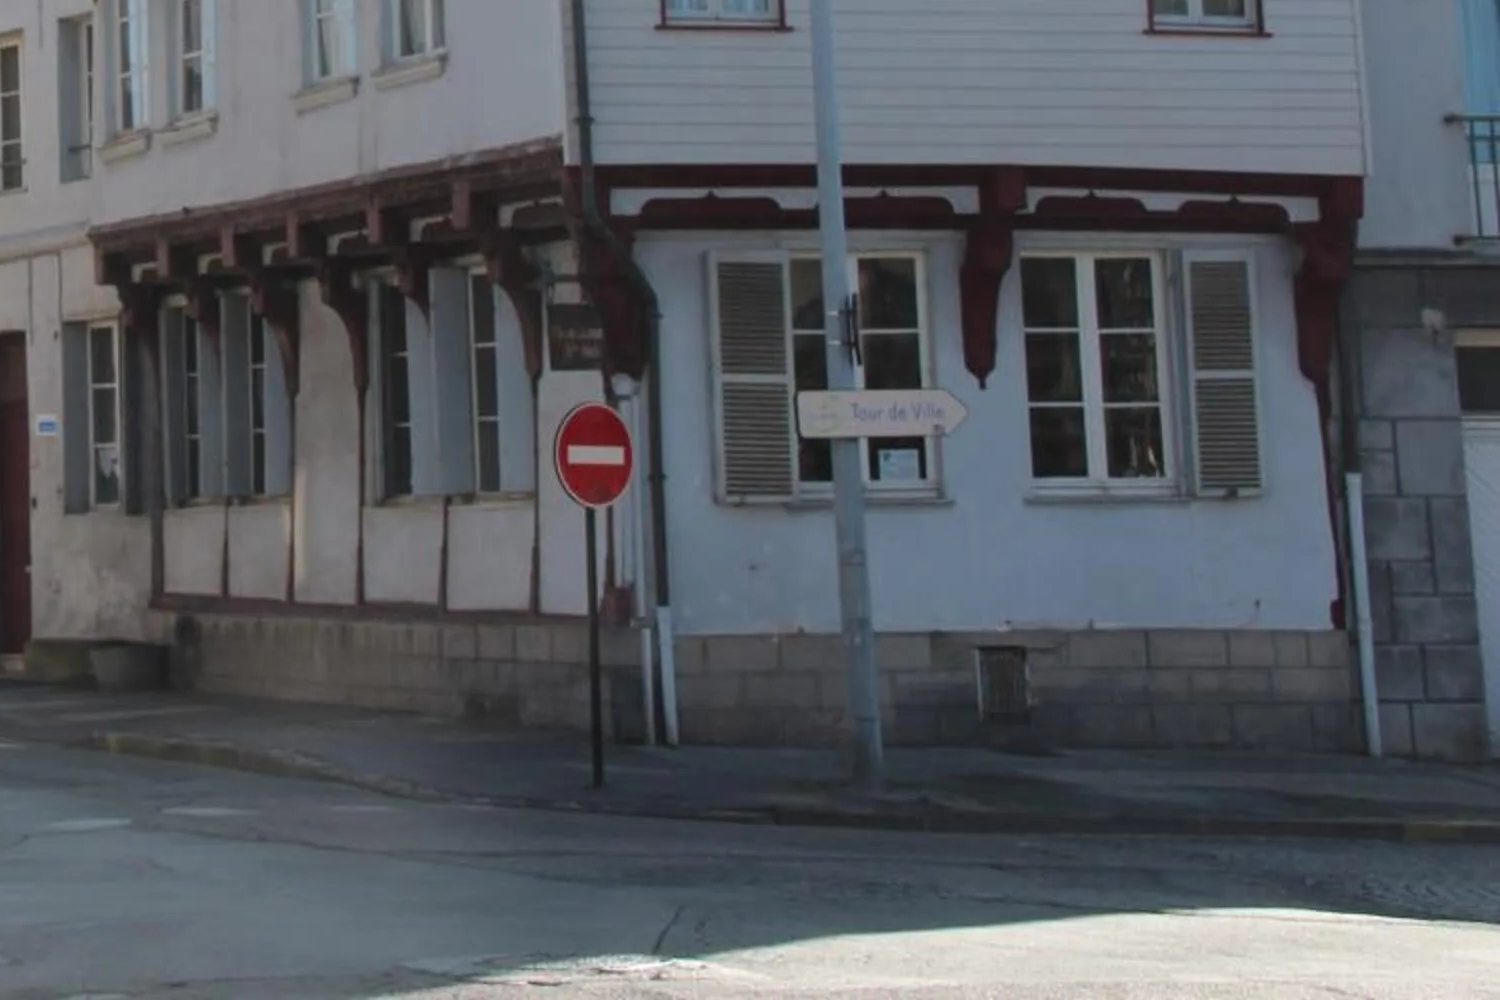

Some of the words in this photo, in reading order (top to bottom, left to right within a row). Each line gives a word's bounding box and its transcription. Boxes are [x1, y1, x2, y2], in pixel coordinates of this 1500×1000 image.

[849, 402, 884, 421] Tour
[888, 401, 907, 420] de
[910, 401, 946, 420] Ville
